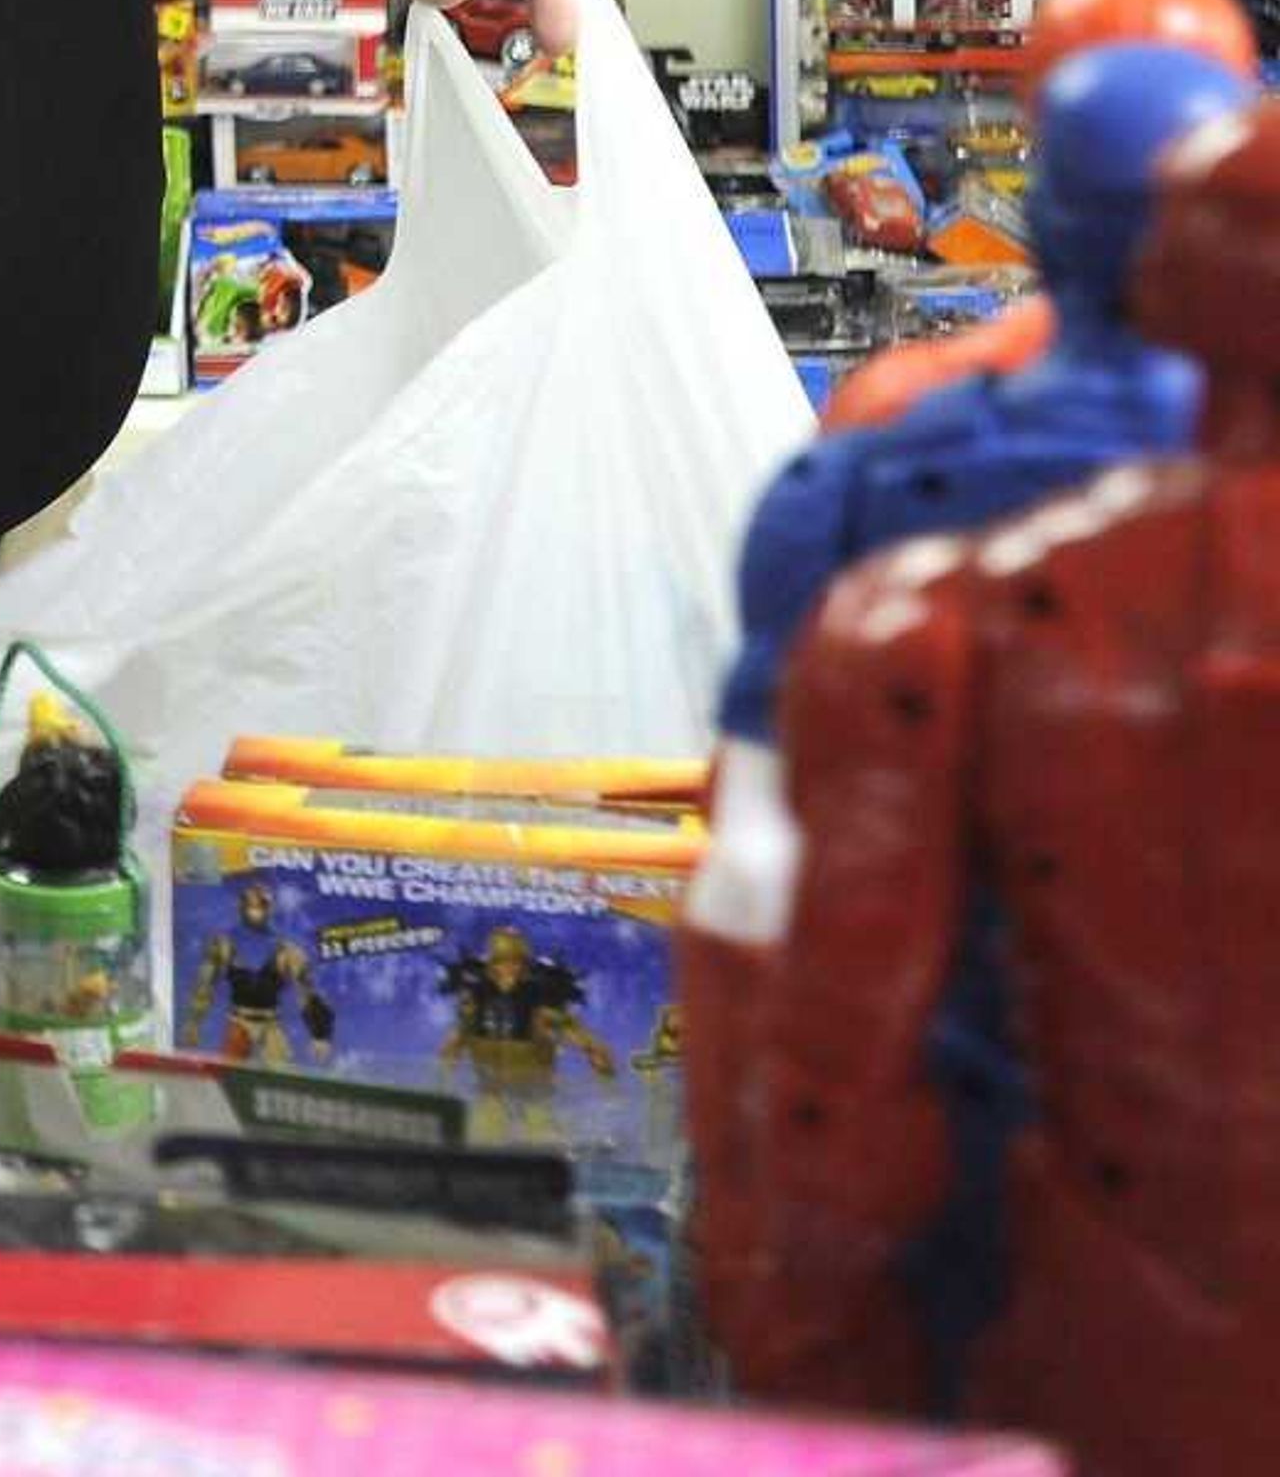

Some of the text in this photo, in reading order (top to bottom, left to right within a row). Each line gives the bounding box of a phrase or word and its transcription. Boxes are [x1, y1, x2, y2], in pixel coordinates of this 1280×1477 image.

[679, 73, 755, 95] STAR
[681, 91, 751, 112] WARS
[247, 845, 315, 872] CAN
[319, 850, 388, 876] YOU
[391, 855, 513, 886] CREATE
[316, 874, 396, 902] WWE
